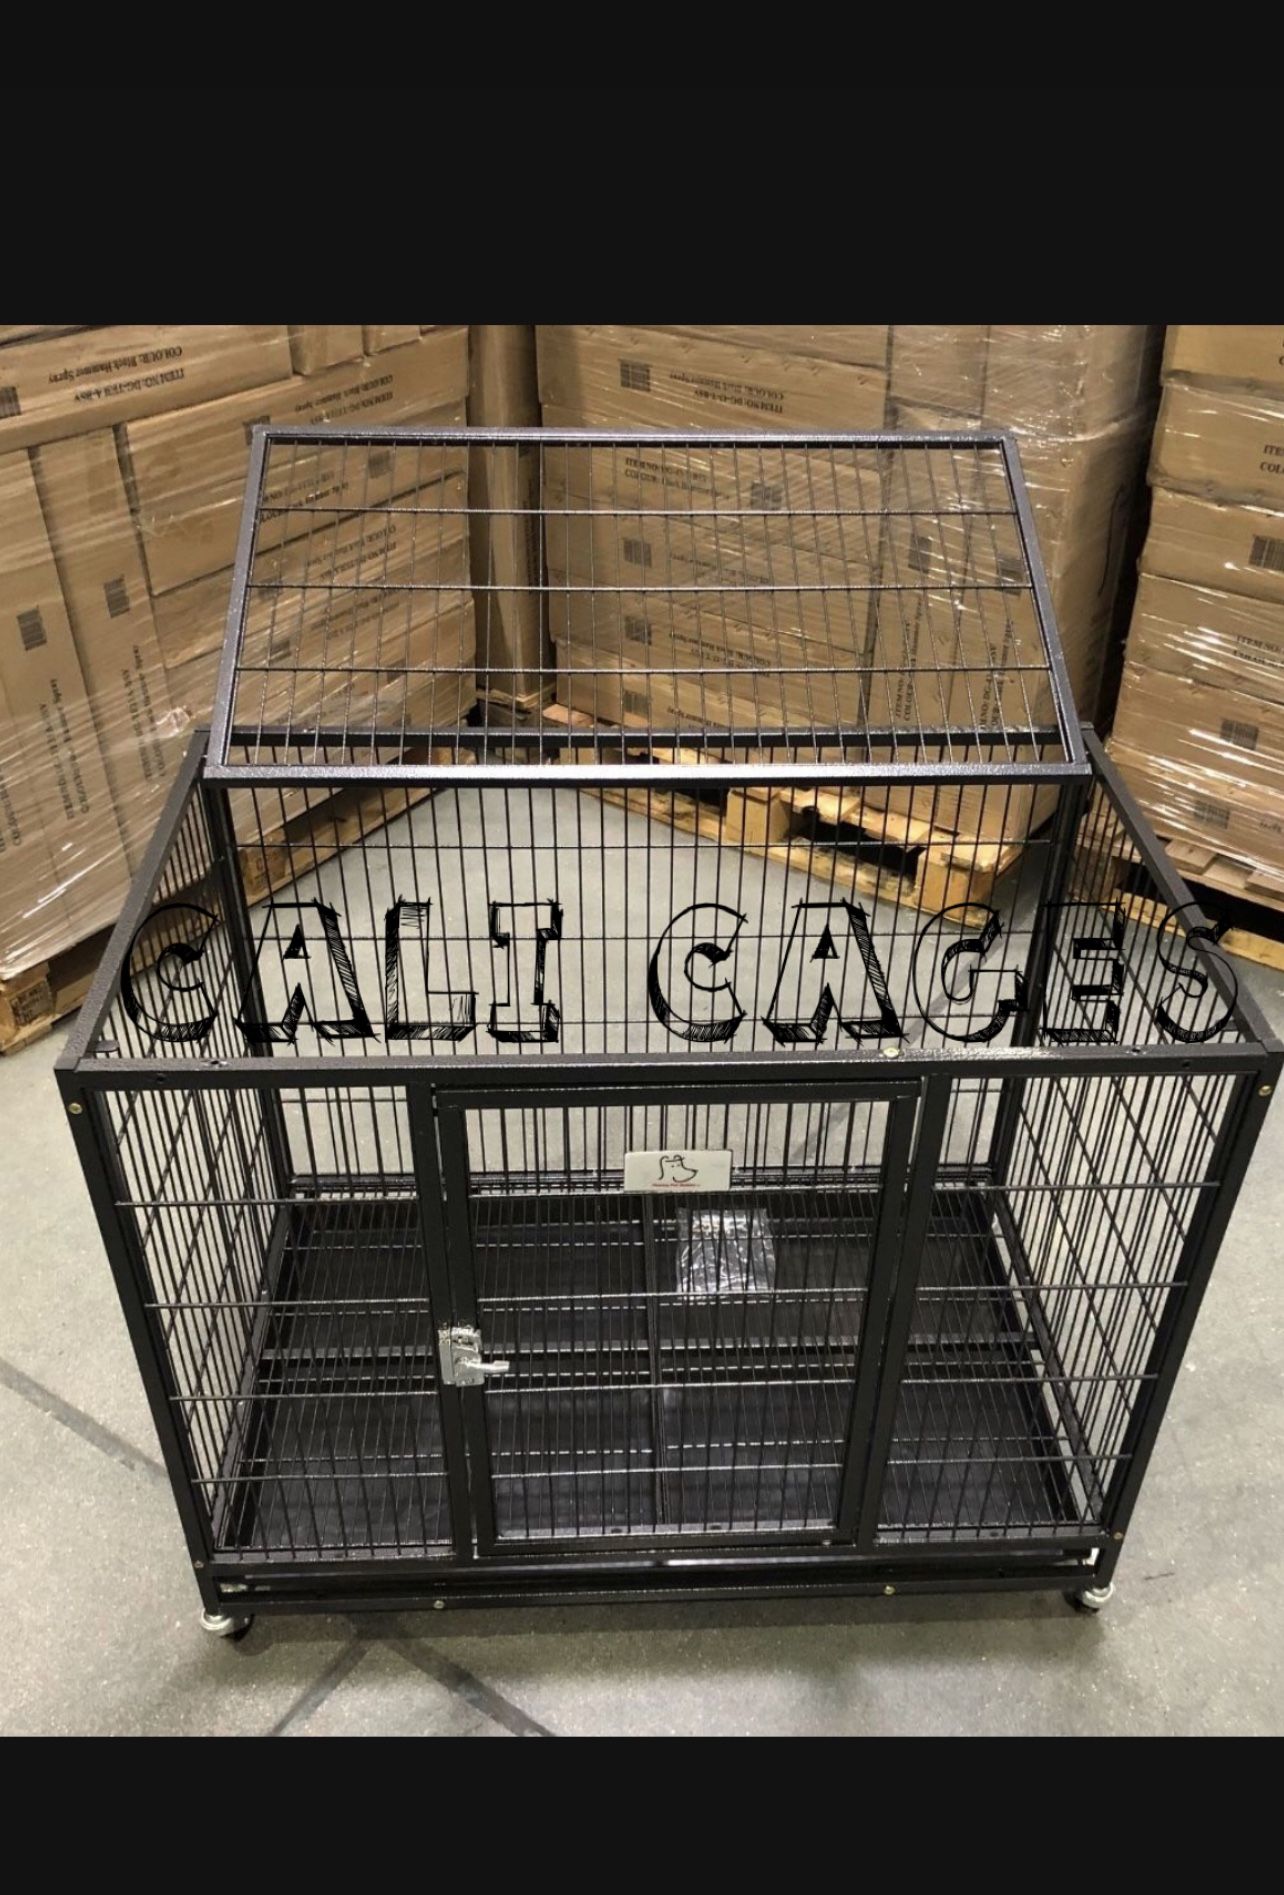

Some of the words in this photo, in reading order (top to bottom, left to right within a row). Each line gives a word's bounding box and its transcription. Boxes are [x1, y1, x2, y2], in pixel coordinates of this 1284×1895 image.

[139, 346, 182, 364] COLOUR:
[75, 361, 112, 378] Hammer
[113, 356, 138, 372] Black
[48, 369, 74, 384] Spray
[142, 375, 159, 389] NO:
[160, 368, 184, 385] ITEM
